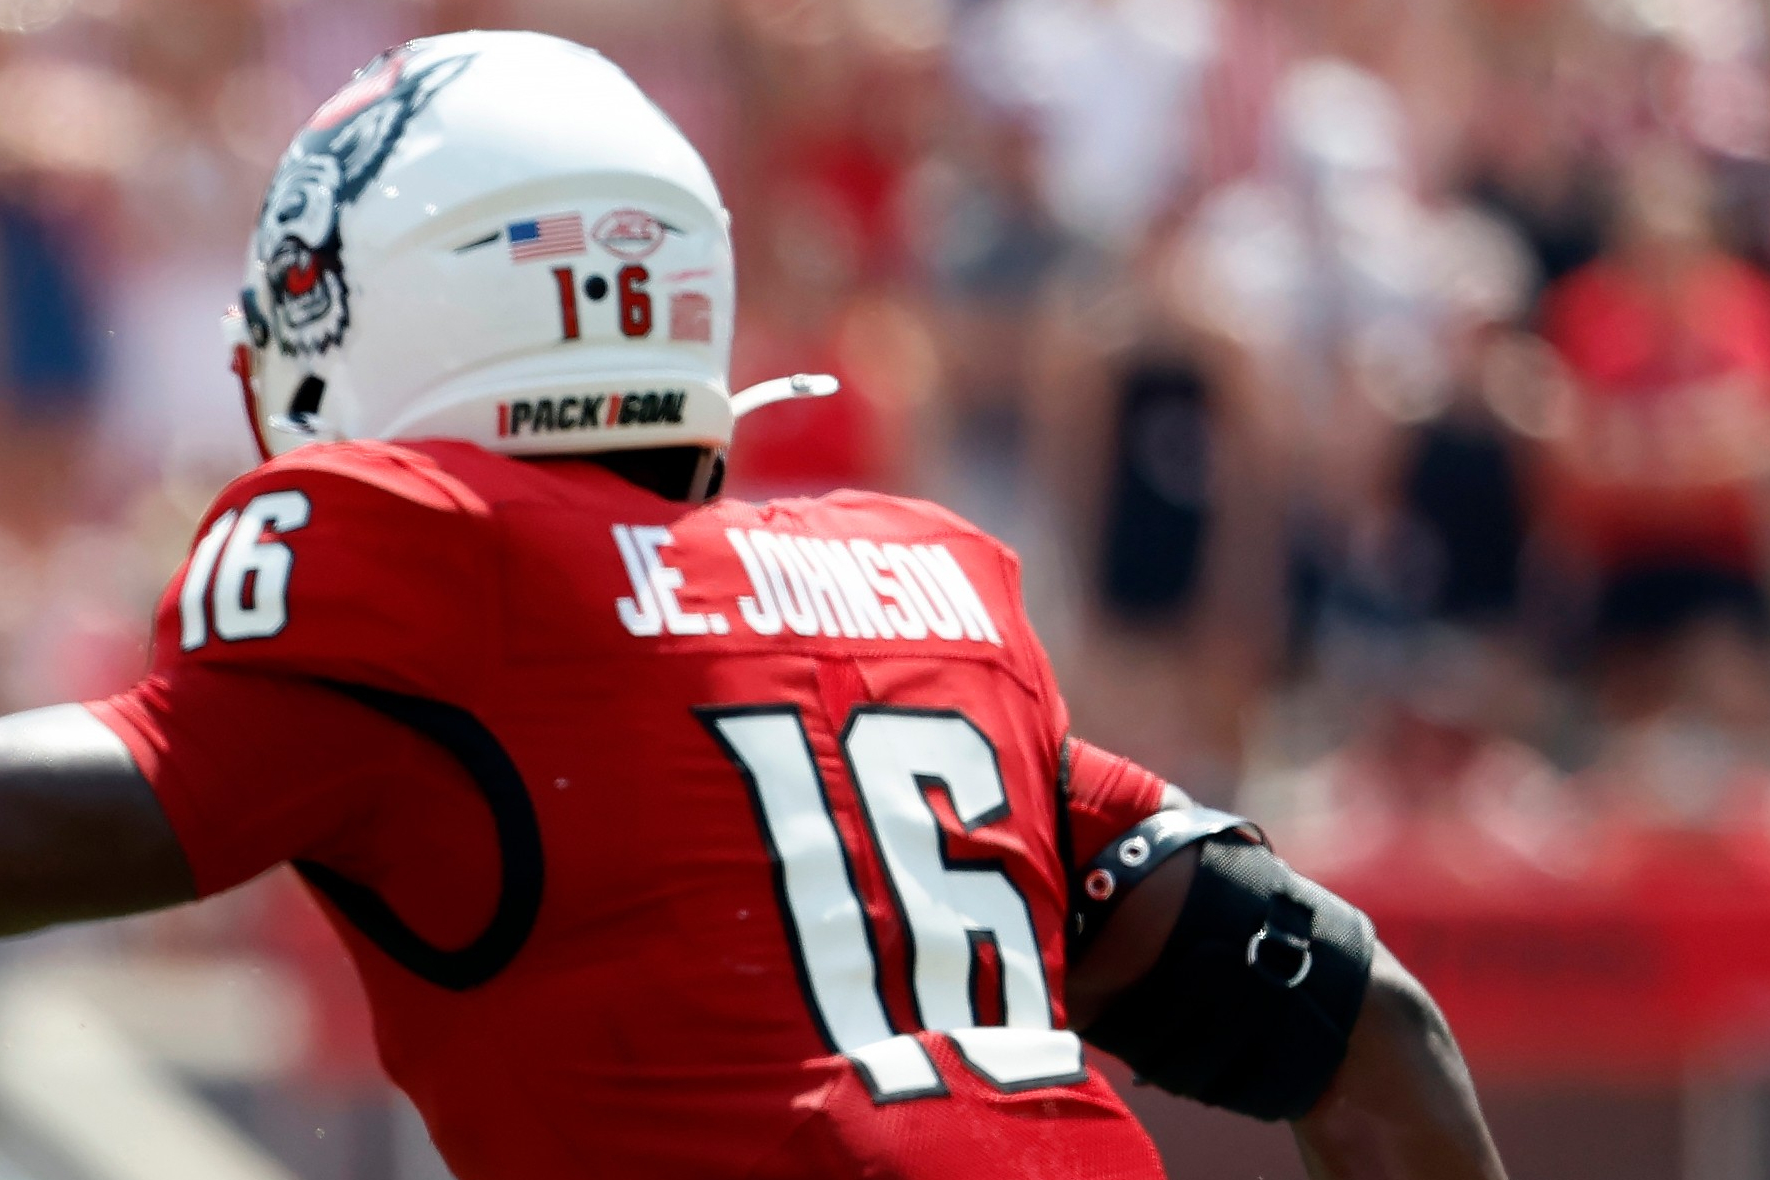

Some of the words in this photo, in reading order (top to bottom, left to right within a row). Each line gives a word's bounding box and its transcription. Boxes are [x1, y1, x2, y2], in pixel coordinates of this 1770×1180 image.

[551, 263, 653, 343] 16
[180, 489, 312, 653] 16
[611, 522, 730, 638] JE.
[724, 526, 1005, 649] JOHNSON
[690, 702, 1089, 1106] 16
